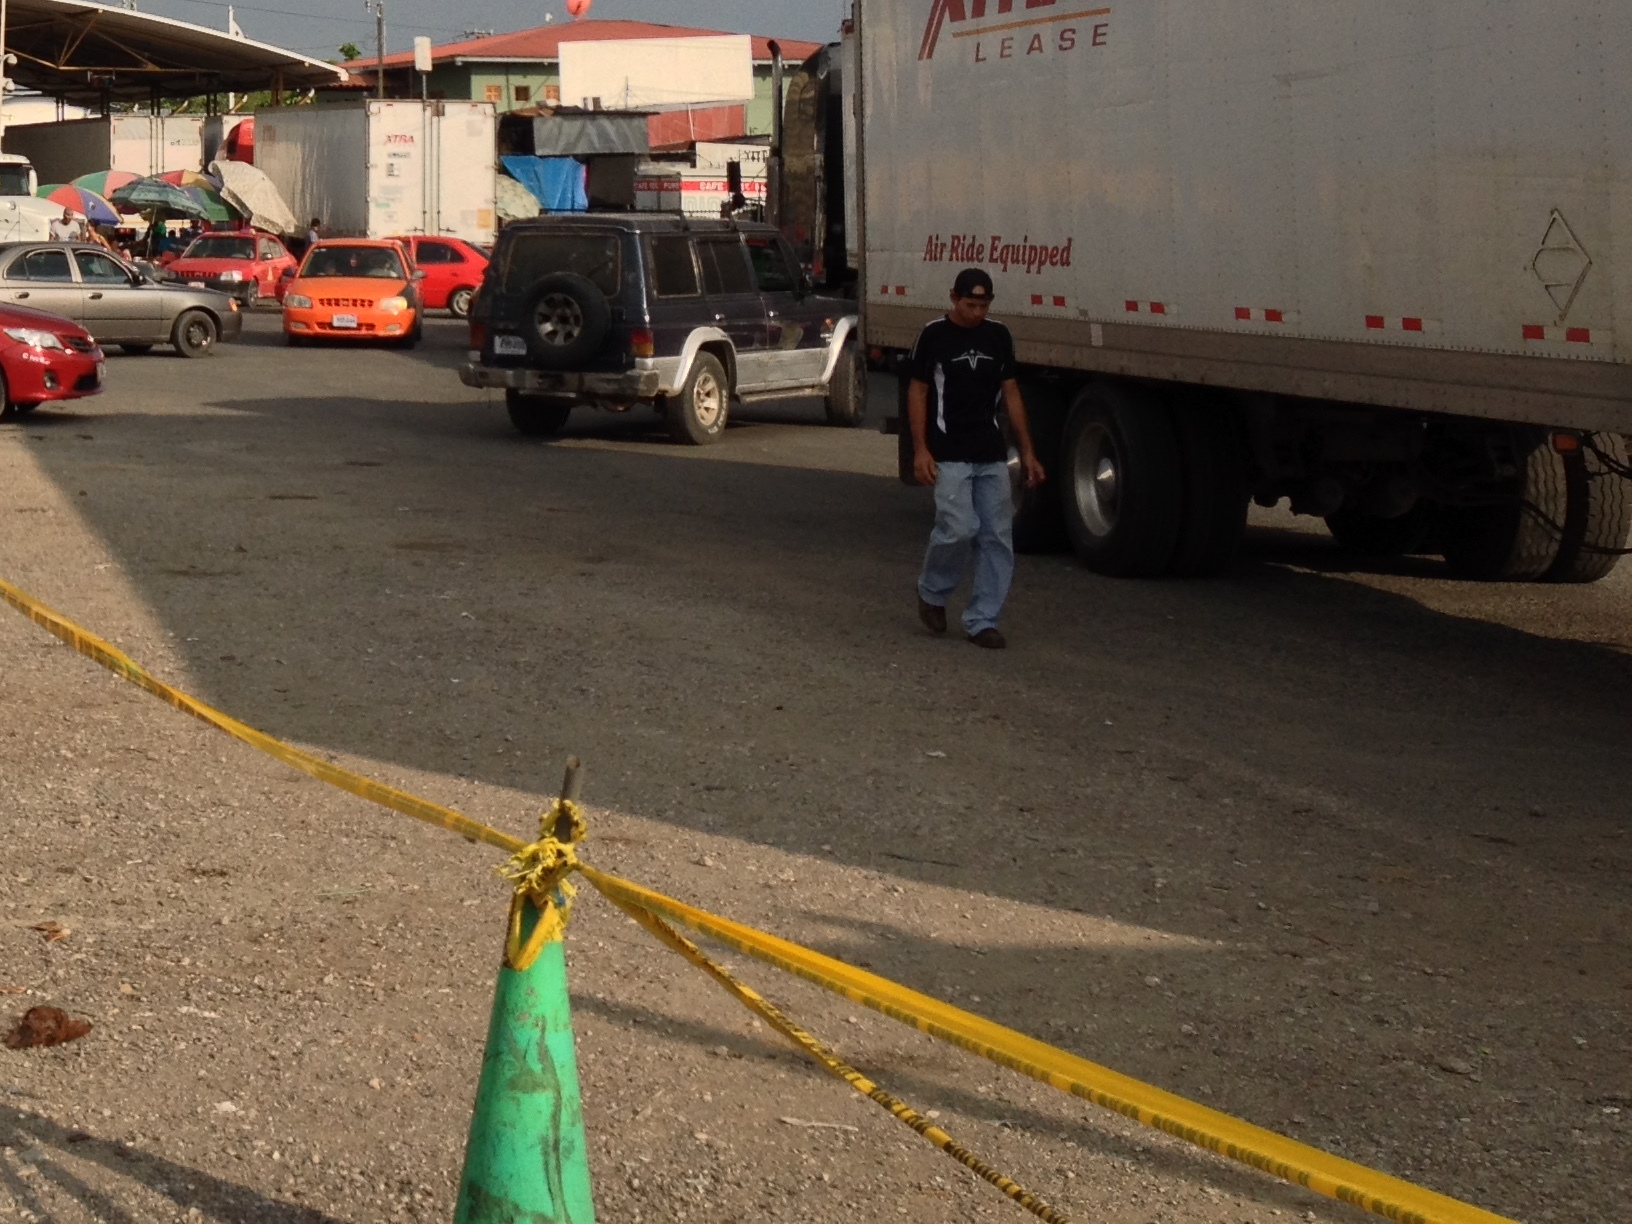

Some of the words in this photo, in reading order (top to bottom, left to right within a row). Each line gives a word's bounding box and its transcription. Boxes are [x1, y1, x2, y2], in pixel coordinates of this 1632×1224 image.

[975, 23, 1109, 63] LEASE
[923, 234, 946, 262] Air
[948, 234, 985, 263] Ride
[988, 235, 1073, 274] Equipped
